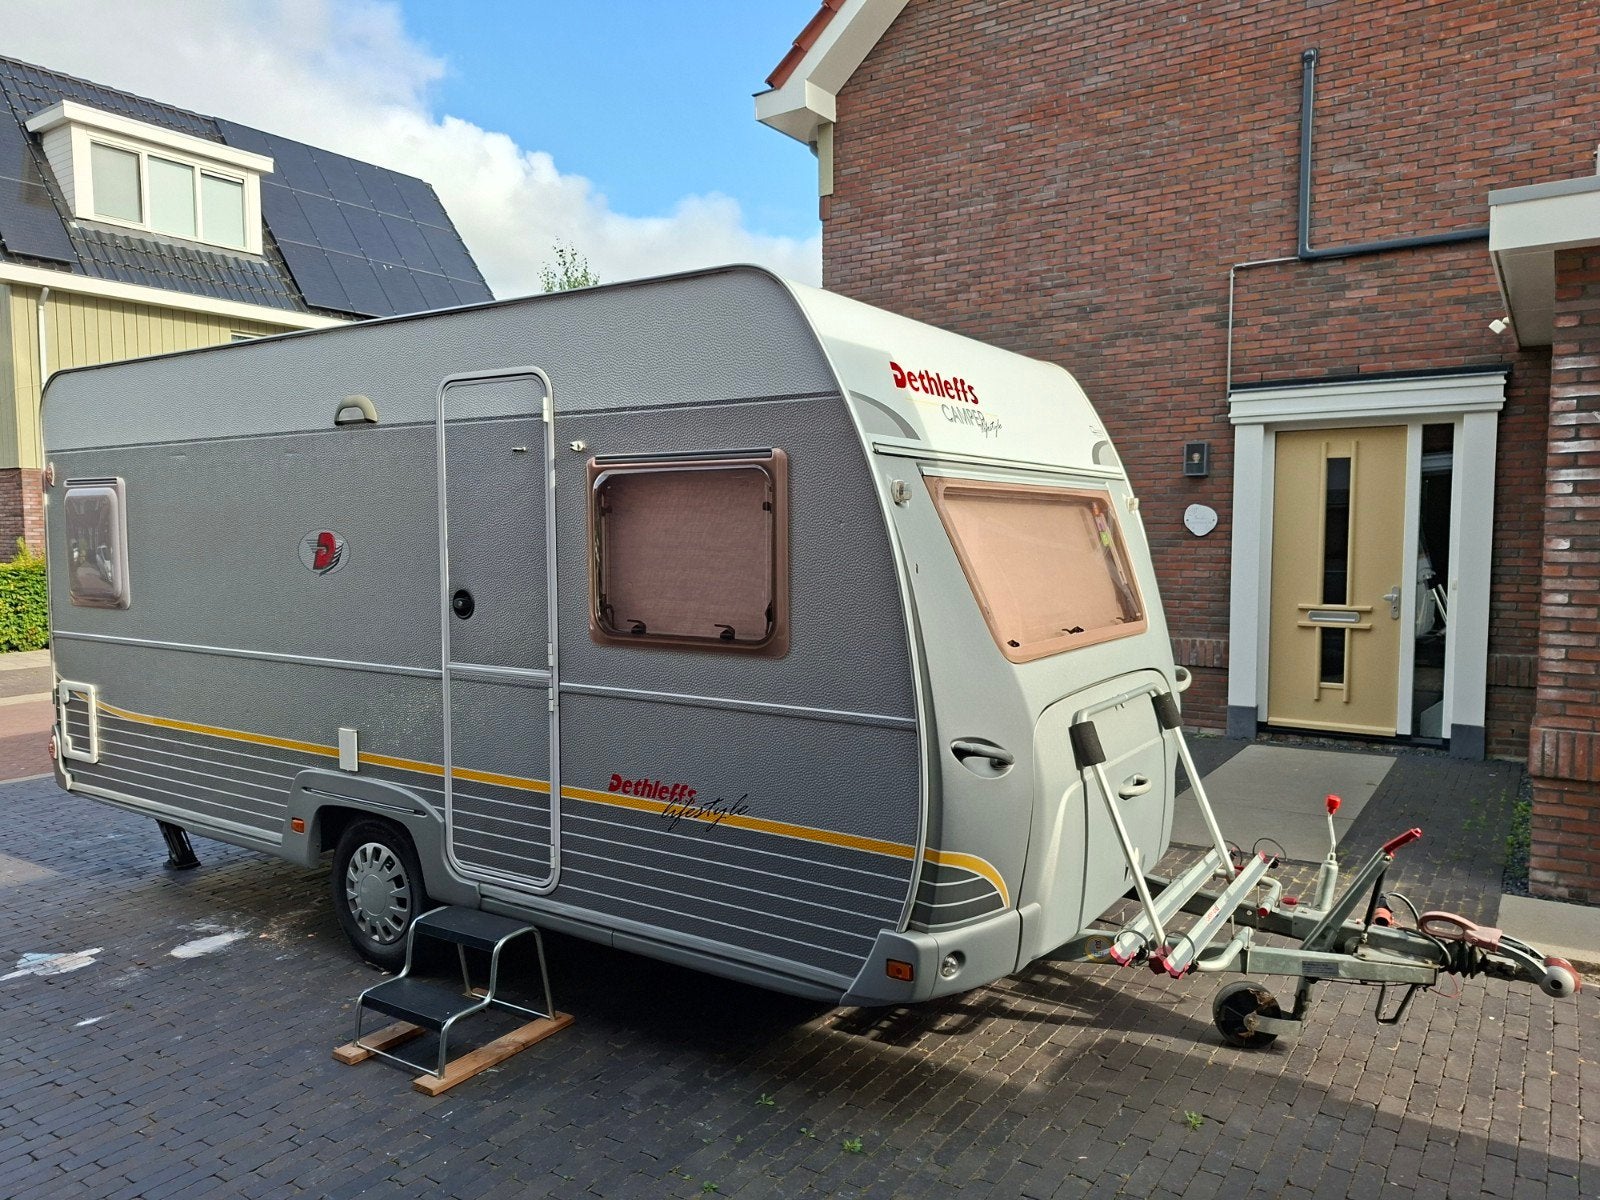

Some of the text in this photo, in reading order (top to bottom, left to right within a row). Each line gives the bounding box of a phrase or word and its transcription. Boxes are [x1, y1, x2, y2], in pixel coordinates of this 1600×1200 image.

[889, 361, 979, 405] Dethleffs
[608, 773, 698, 806] Dethleffs
[661, 793, 750, 833] lifestyle
